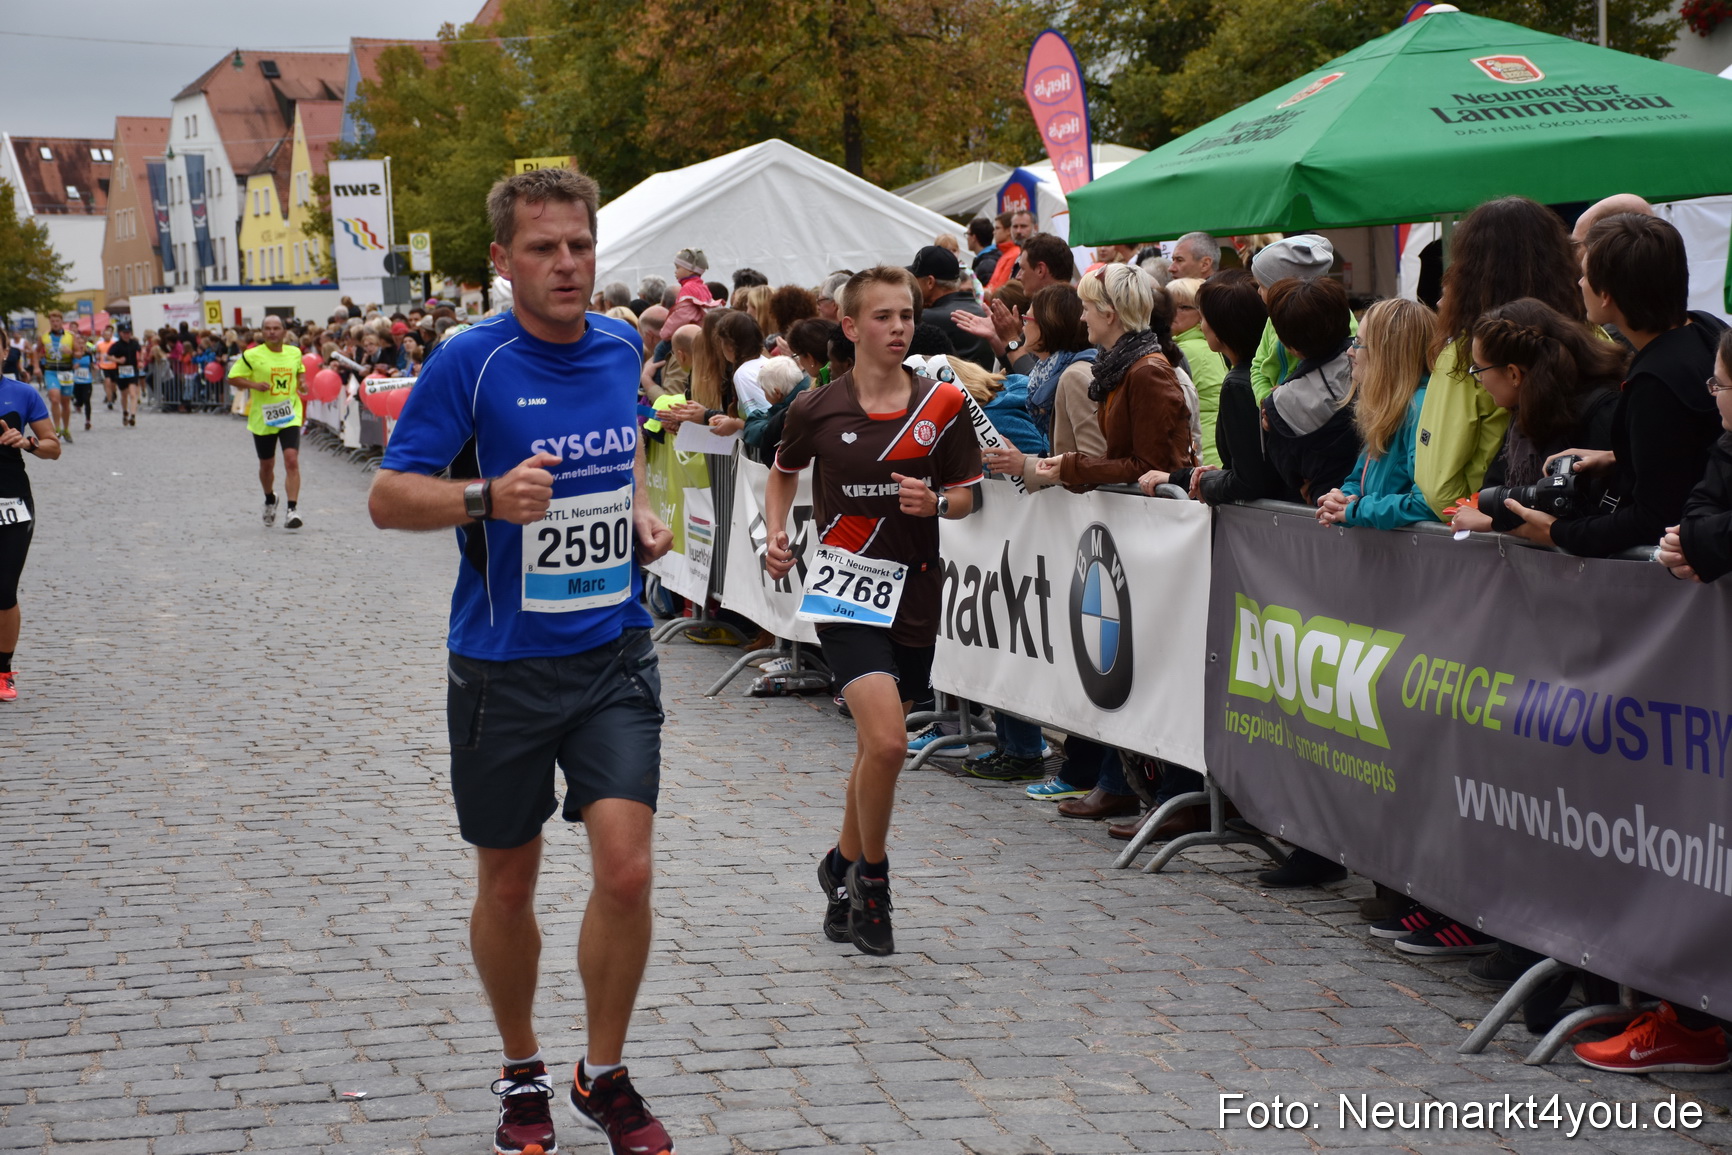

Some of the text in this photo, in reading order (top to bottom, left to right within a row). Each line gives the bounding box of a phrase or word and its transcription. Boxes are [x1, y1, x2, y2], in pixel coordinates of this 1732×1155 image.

[1429, 92, 1676, 124] Lammsbräu
[1451, 84, 1621, 106] Neumarkter
[1455, 112, 1693, 136] DAS FEINE ÖKOLOGISCHE BIER
[209, 306, 218, 320] D
[276, 379, 287, 389] M
[265, 405, 291, 421] 2390
[527, 398, 547, 406] JAKO
[530, 426, 636, 460] SYSCAD
[544, 503, 623, 521] RTL Neumarkt
[537, 517, 628, 568] 2590
[816, 549, 891, 577] PARTL Neumarkt
[1076, 529, 1125, 592] BMW
[568, 578, 605, 595] Marc
[812, 565, 893, 609] 2768
[833, 604, 855, 618] Jan
[1235, 607, 1390, 730] BOCK
[1401, 653, 1732, 778] OFFICE INDUSTRY
[1225, 702, 1283, 744] inspired
[1295, 735, 1330, 769] smart
[1332, 749, 1396, 795] concepts
